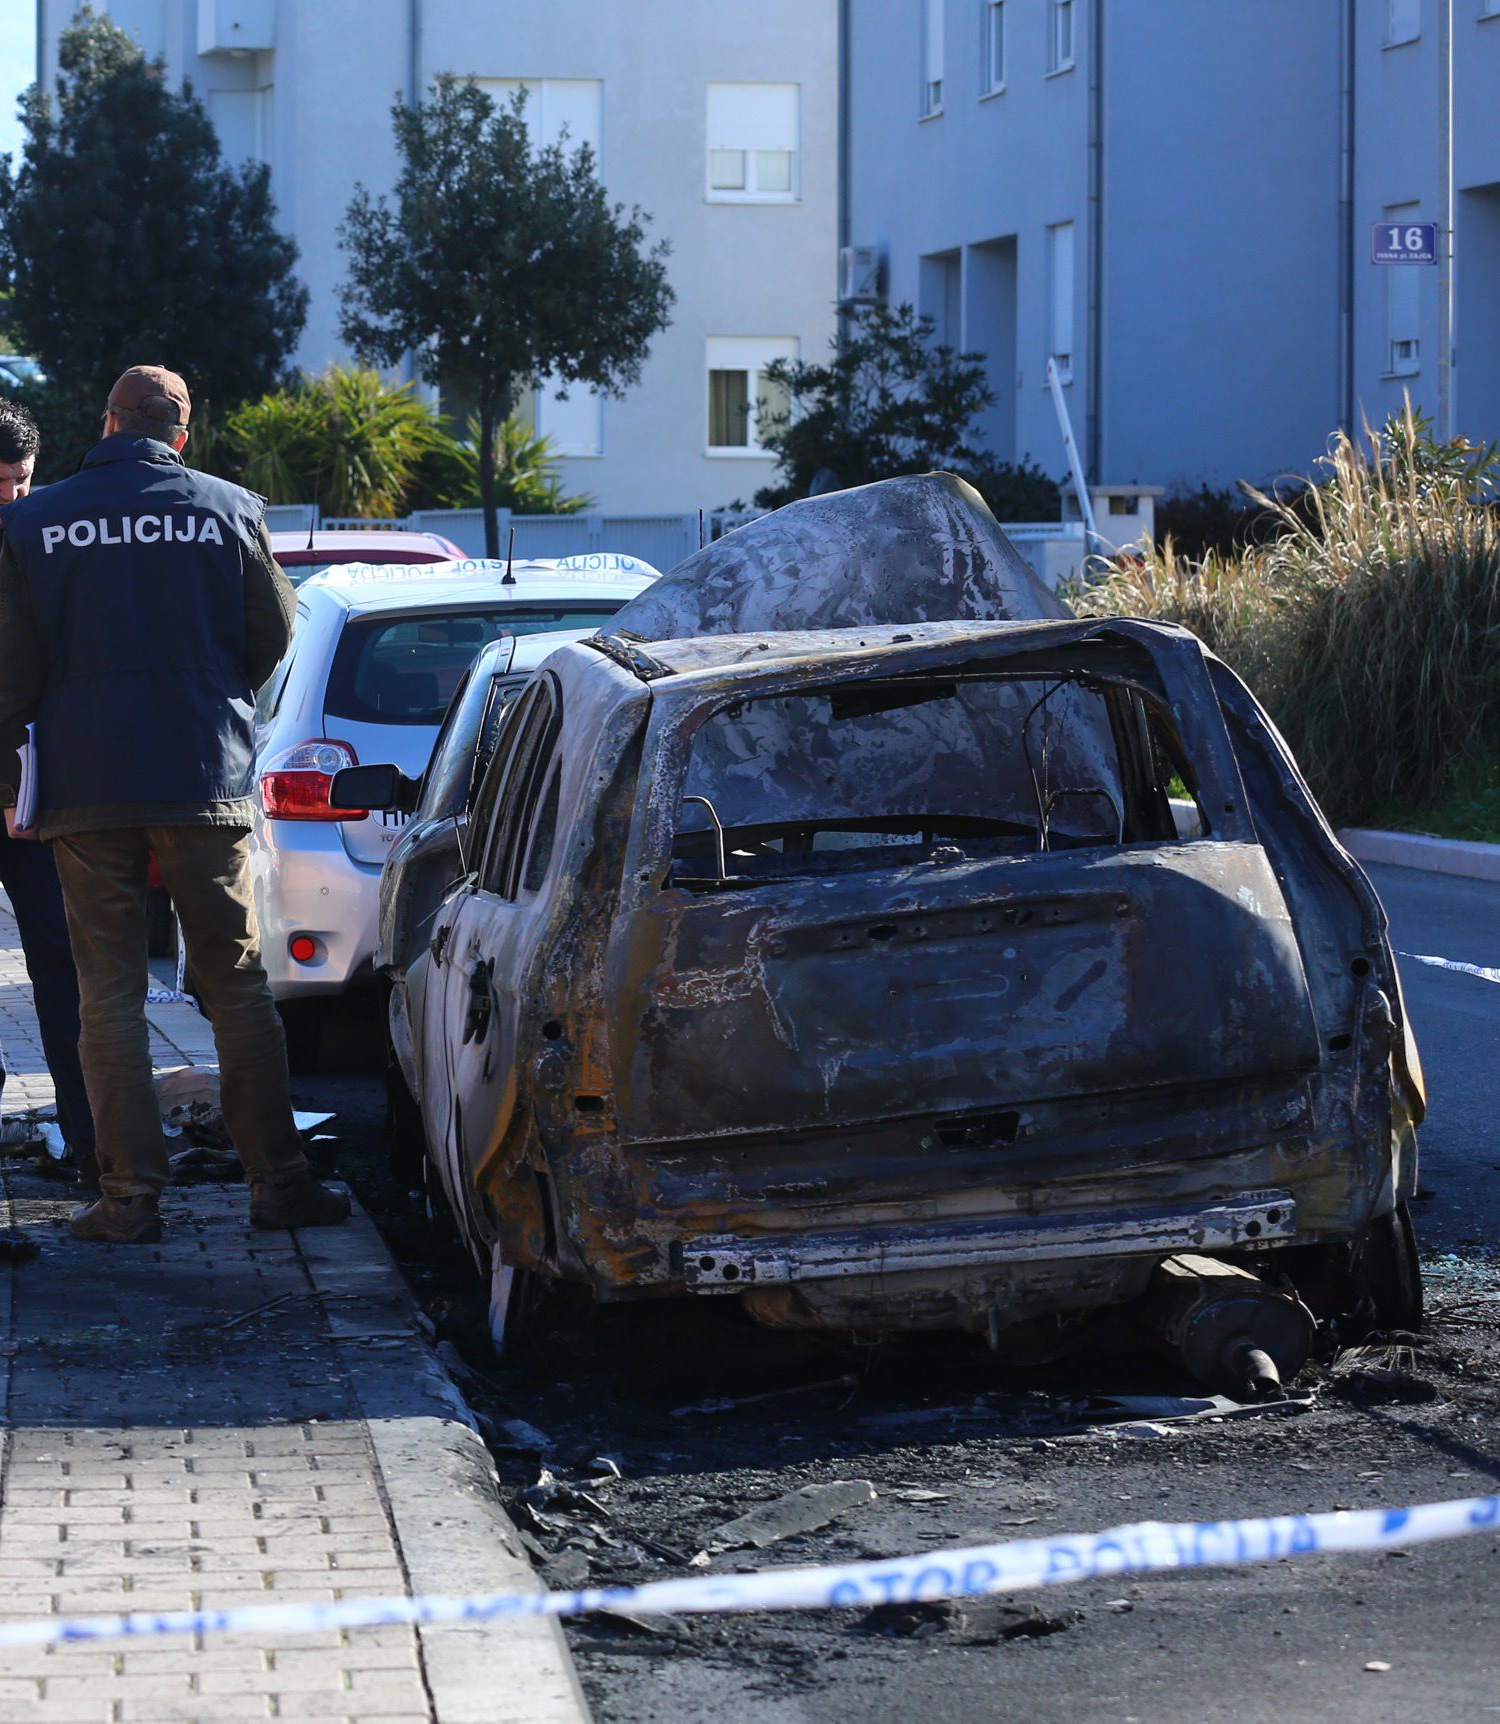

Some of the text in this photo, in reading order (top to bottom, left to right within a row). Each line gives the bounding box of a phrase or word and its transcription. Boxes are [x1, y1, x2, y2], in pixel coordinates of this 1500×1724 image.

[1388, 227, 1422, 250] 16
[41, 515, 224, 554] POLICIJA
[828, 1559, 1000, 1604] STOP
